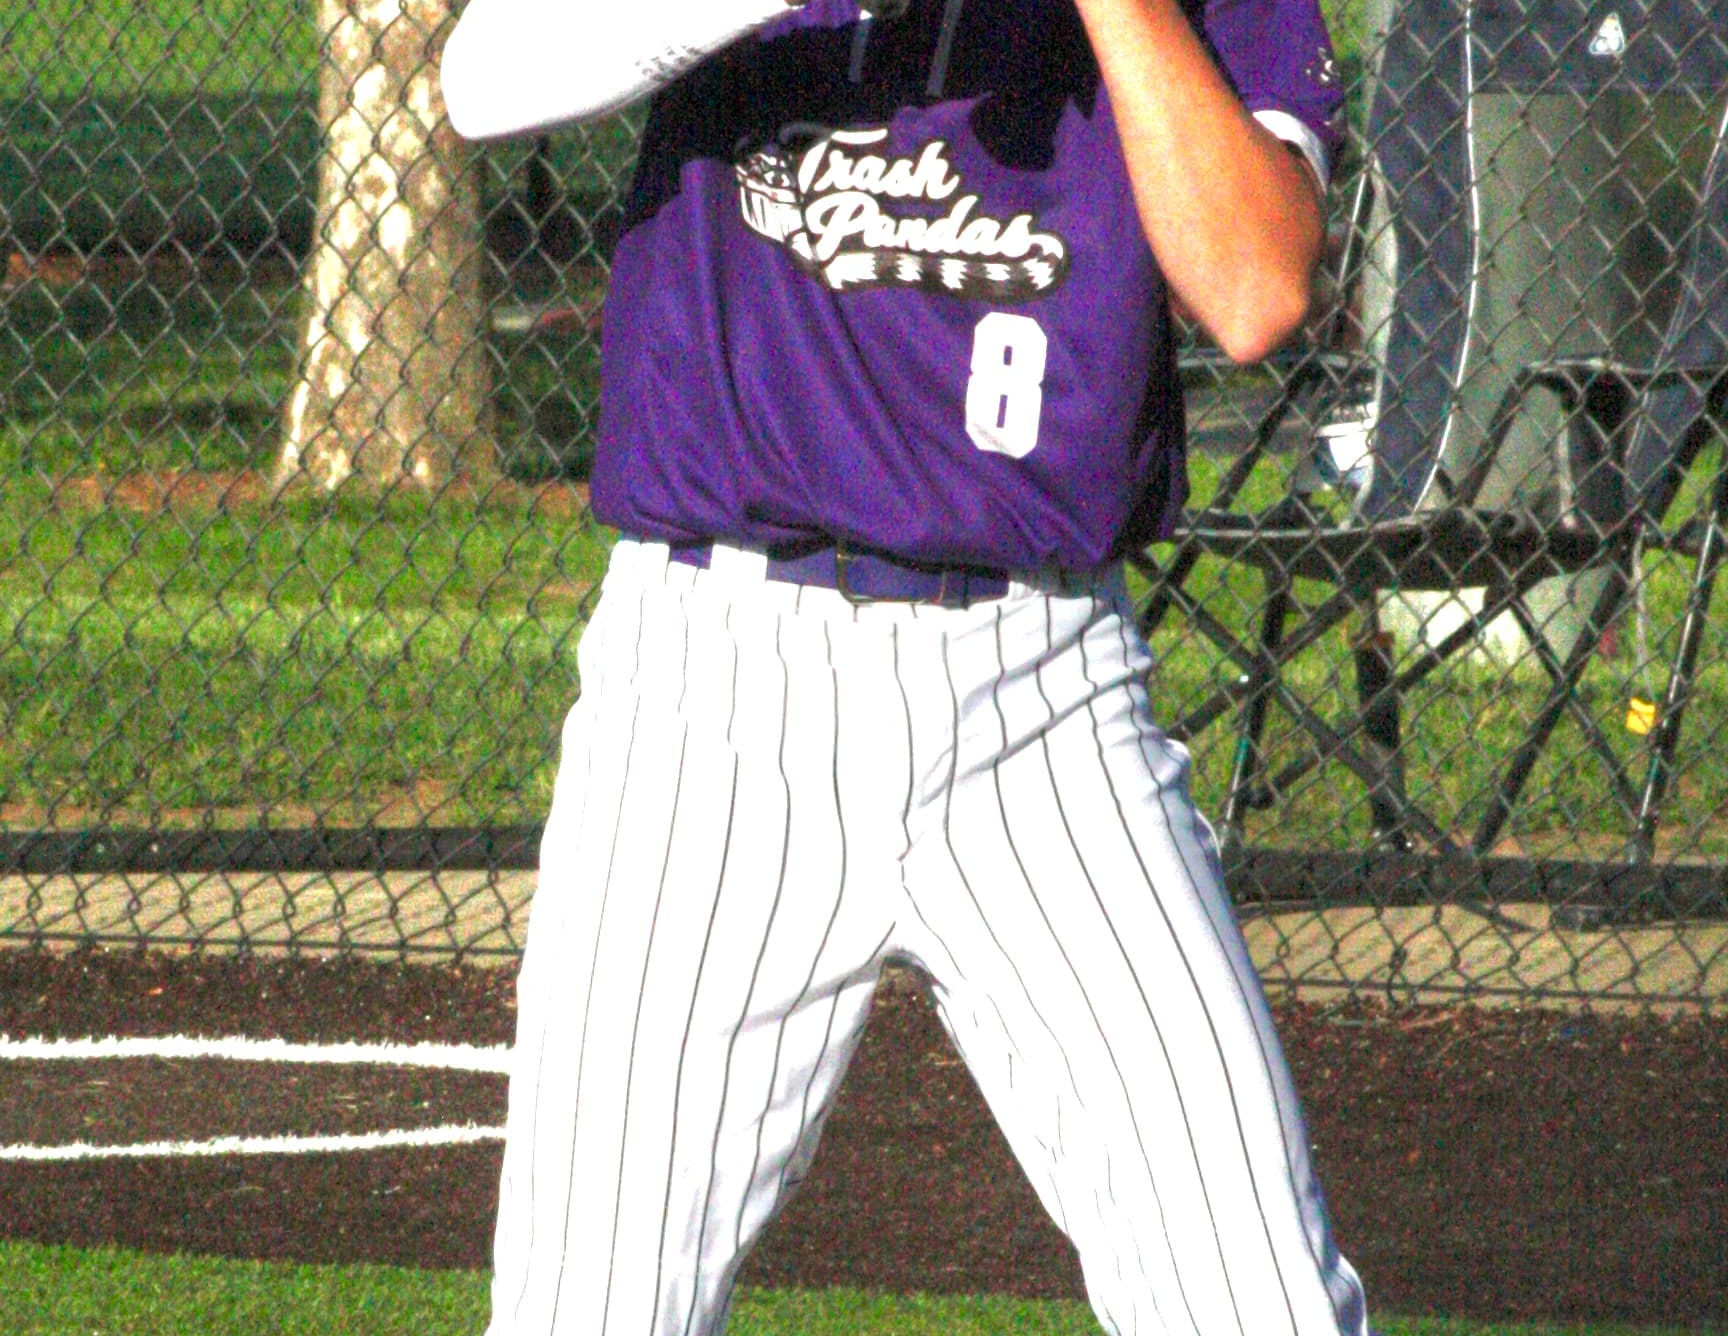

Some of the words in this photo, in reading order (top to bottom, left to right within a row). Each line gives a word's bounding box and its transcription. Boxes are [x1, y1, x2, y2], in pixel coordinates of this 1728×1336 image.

[798, 128, 960, 199] Trash
[805, 190, 1064, 262] Pandas
[965, 311, 1048, 459] 8
